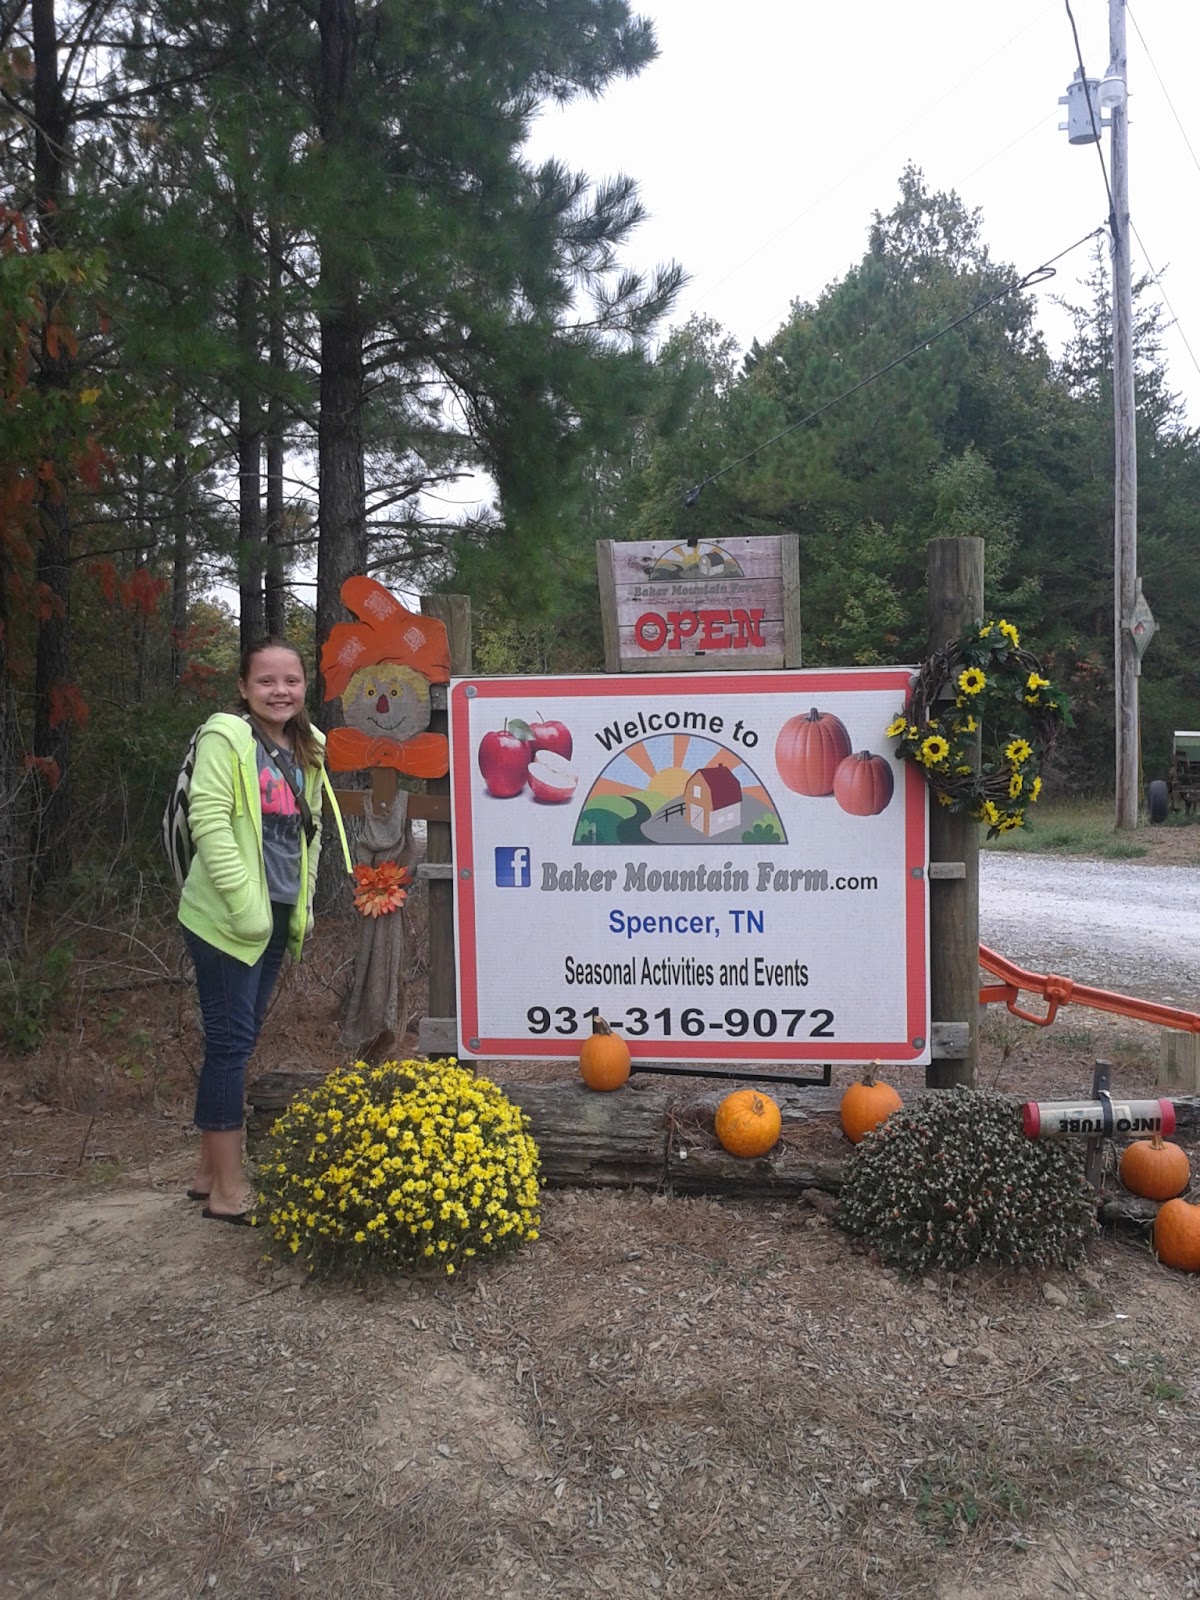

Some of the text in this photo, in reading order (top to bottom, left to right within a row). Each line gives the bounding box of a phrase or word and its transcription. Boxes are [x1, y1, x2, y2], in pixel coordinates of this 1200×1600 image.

[634, 586, 668, 597] Baker
[671, 582, 727, 596] Mountain
[634, 608, 766, 652] OPEN
[595, 710, 759, 751] Welcome to
[541, 861, 878, 892] Baker Mountain Farm.com
[609, 909, 764, 938] Spencer, TN
[565, 956, 809, 986] Seasonal Activities and Events
[526, 1006, 835, 1037] 931-316-9072
[1059, 1117, 1161, 1132] INFO TUBE
